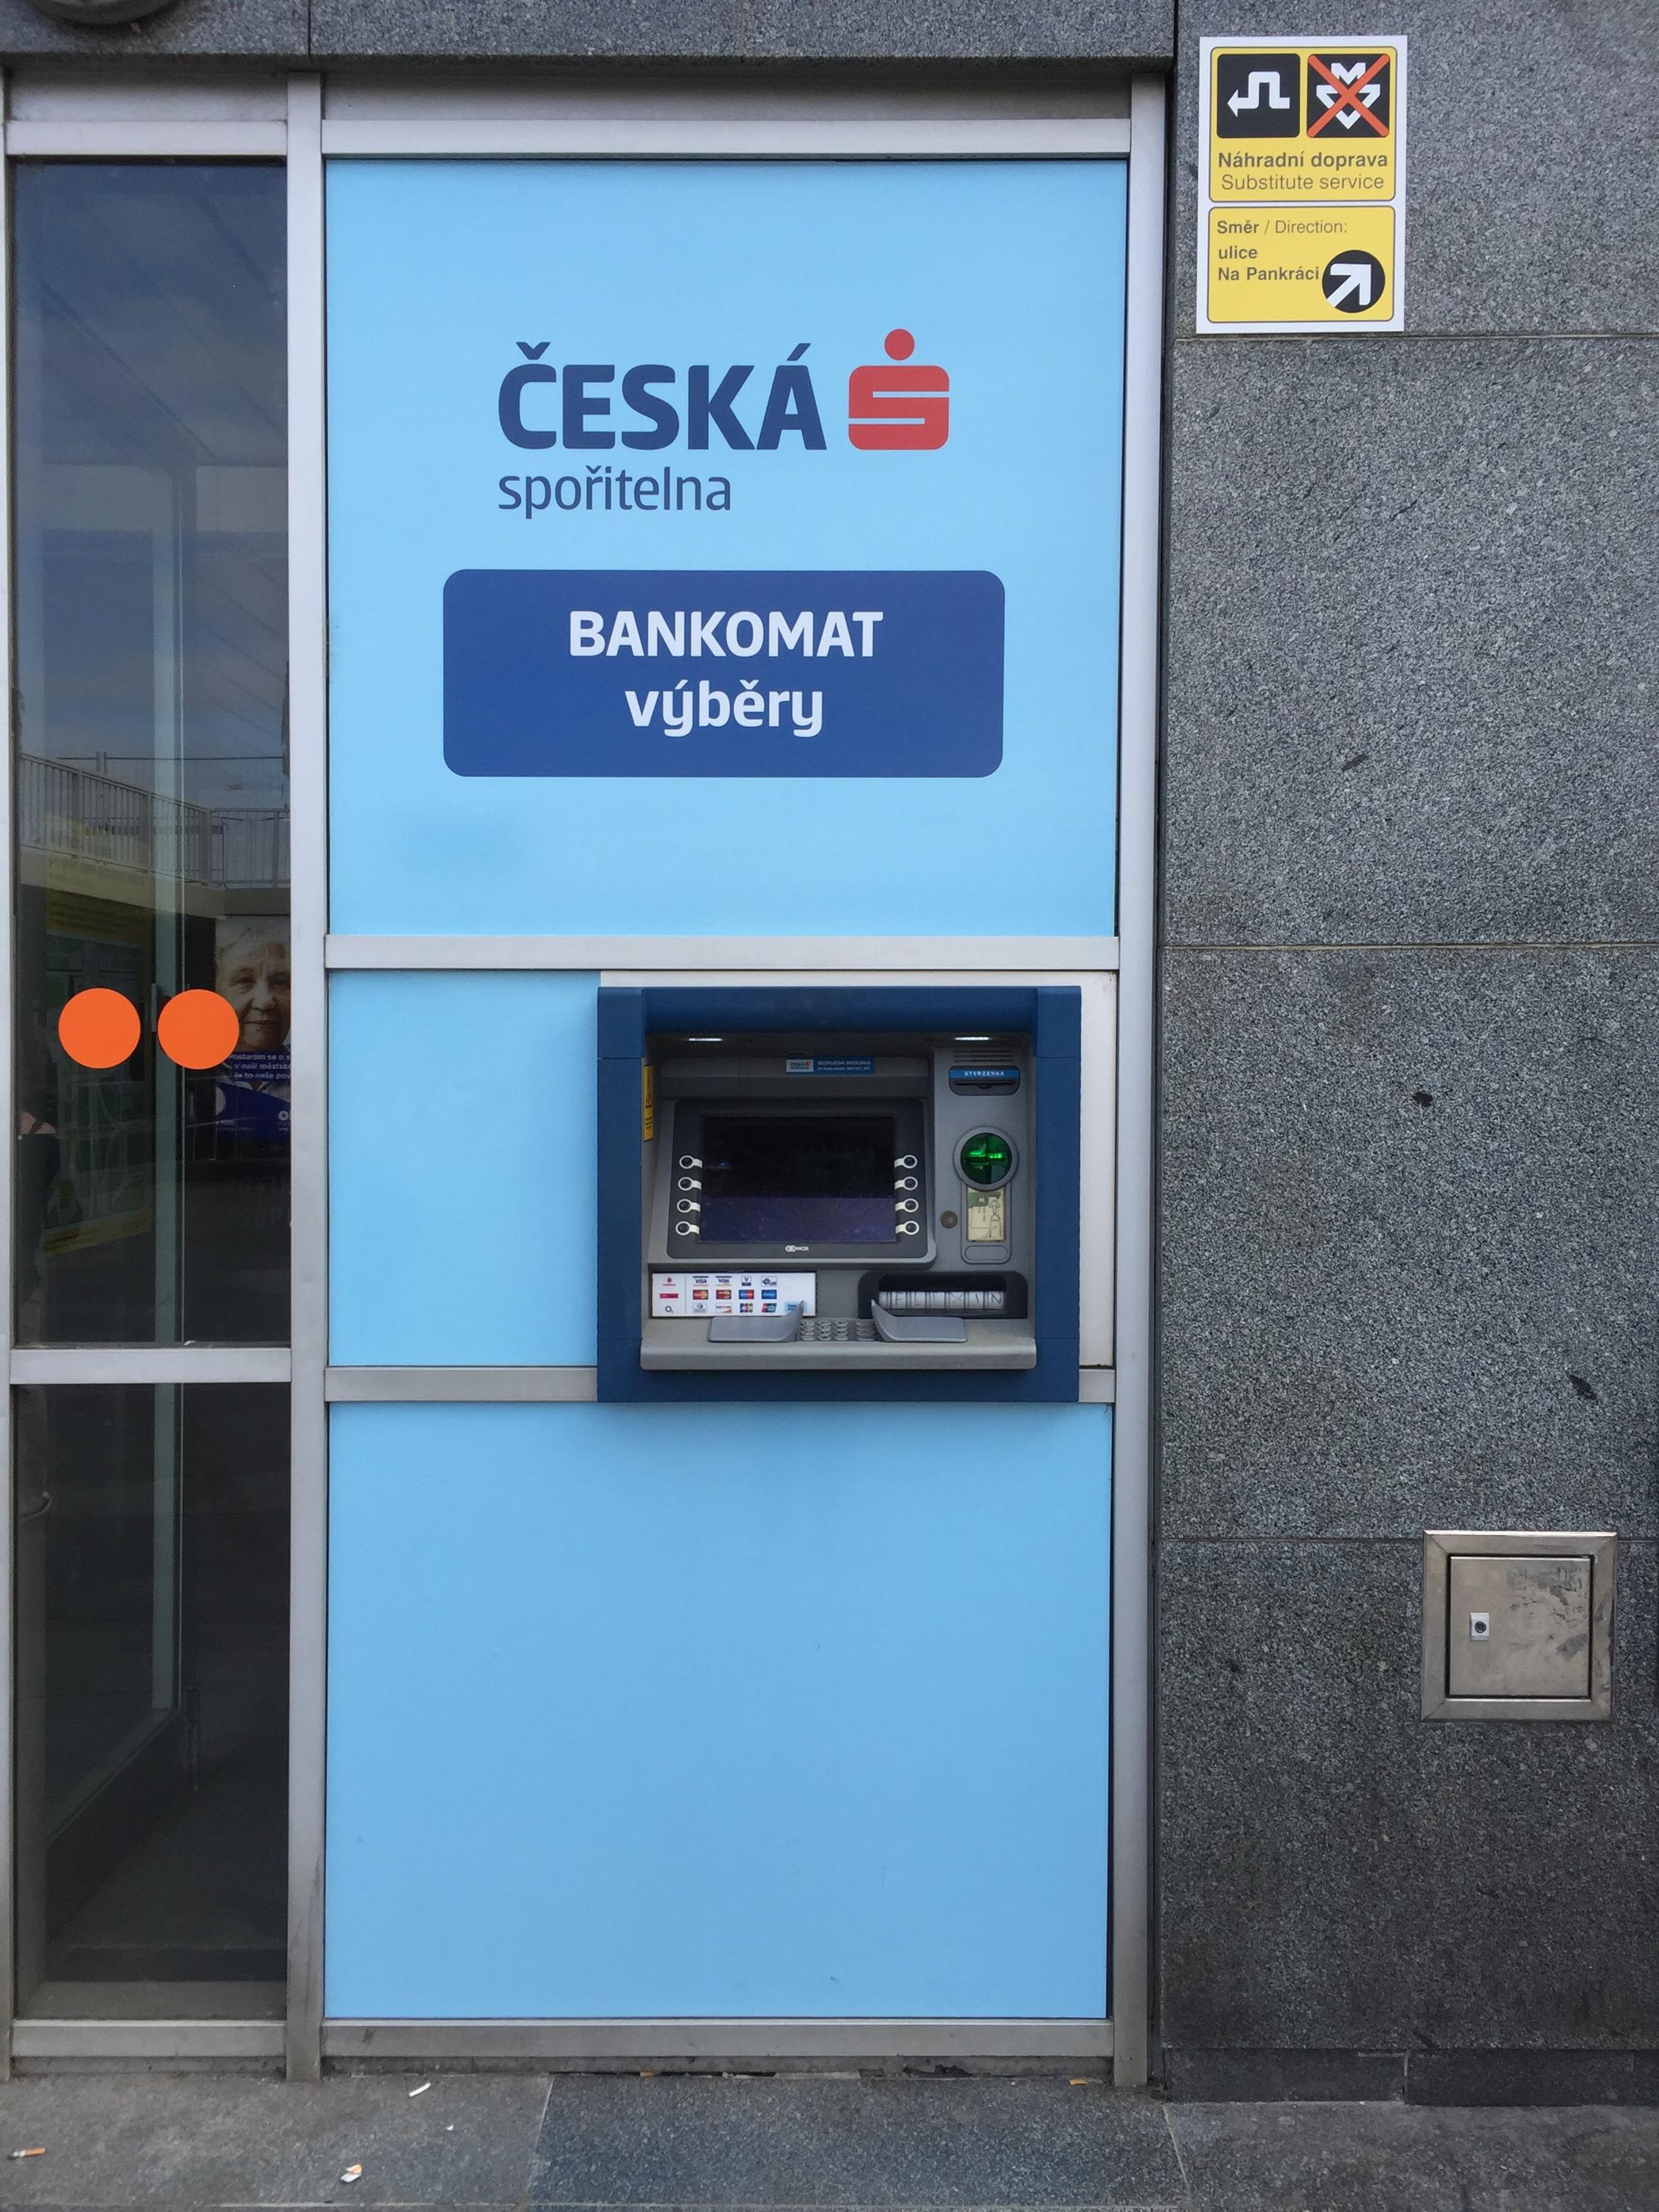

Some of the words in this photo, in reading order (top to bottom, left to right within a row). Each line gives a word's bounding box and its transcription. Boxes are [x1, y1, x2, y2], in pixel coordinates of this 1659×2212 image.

[1218, 150, 1304, 168] Náhradní
[1310, 152, 1388, 170] doprava
[1221, 174, 1314, 190] Substitute
[1319, 175, 1385, 189] service
[1217, 220, 1260, 234] Směr
[1275, 220, 1348, 234] Direction:
[1218, 246, 1258, 260] ulice
[1218, 268, 1240, 281] Na
[1247, 265, 1320, 281] Pankráci
[498, 341, 827, 451] ČESKÁ
[498, 465, 731, 520] spořitelna
[570, 611, 884, 658] BANKOMAT
[625, 679, 824, 737] výběry
